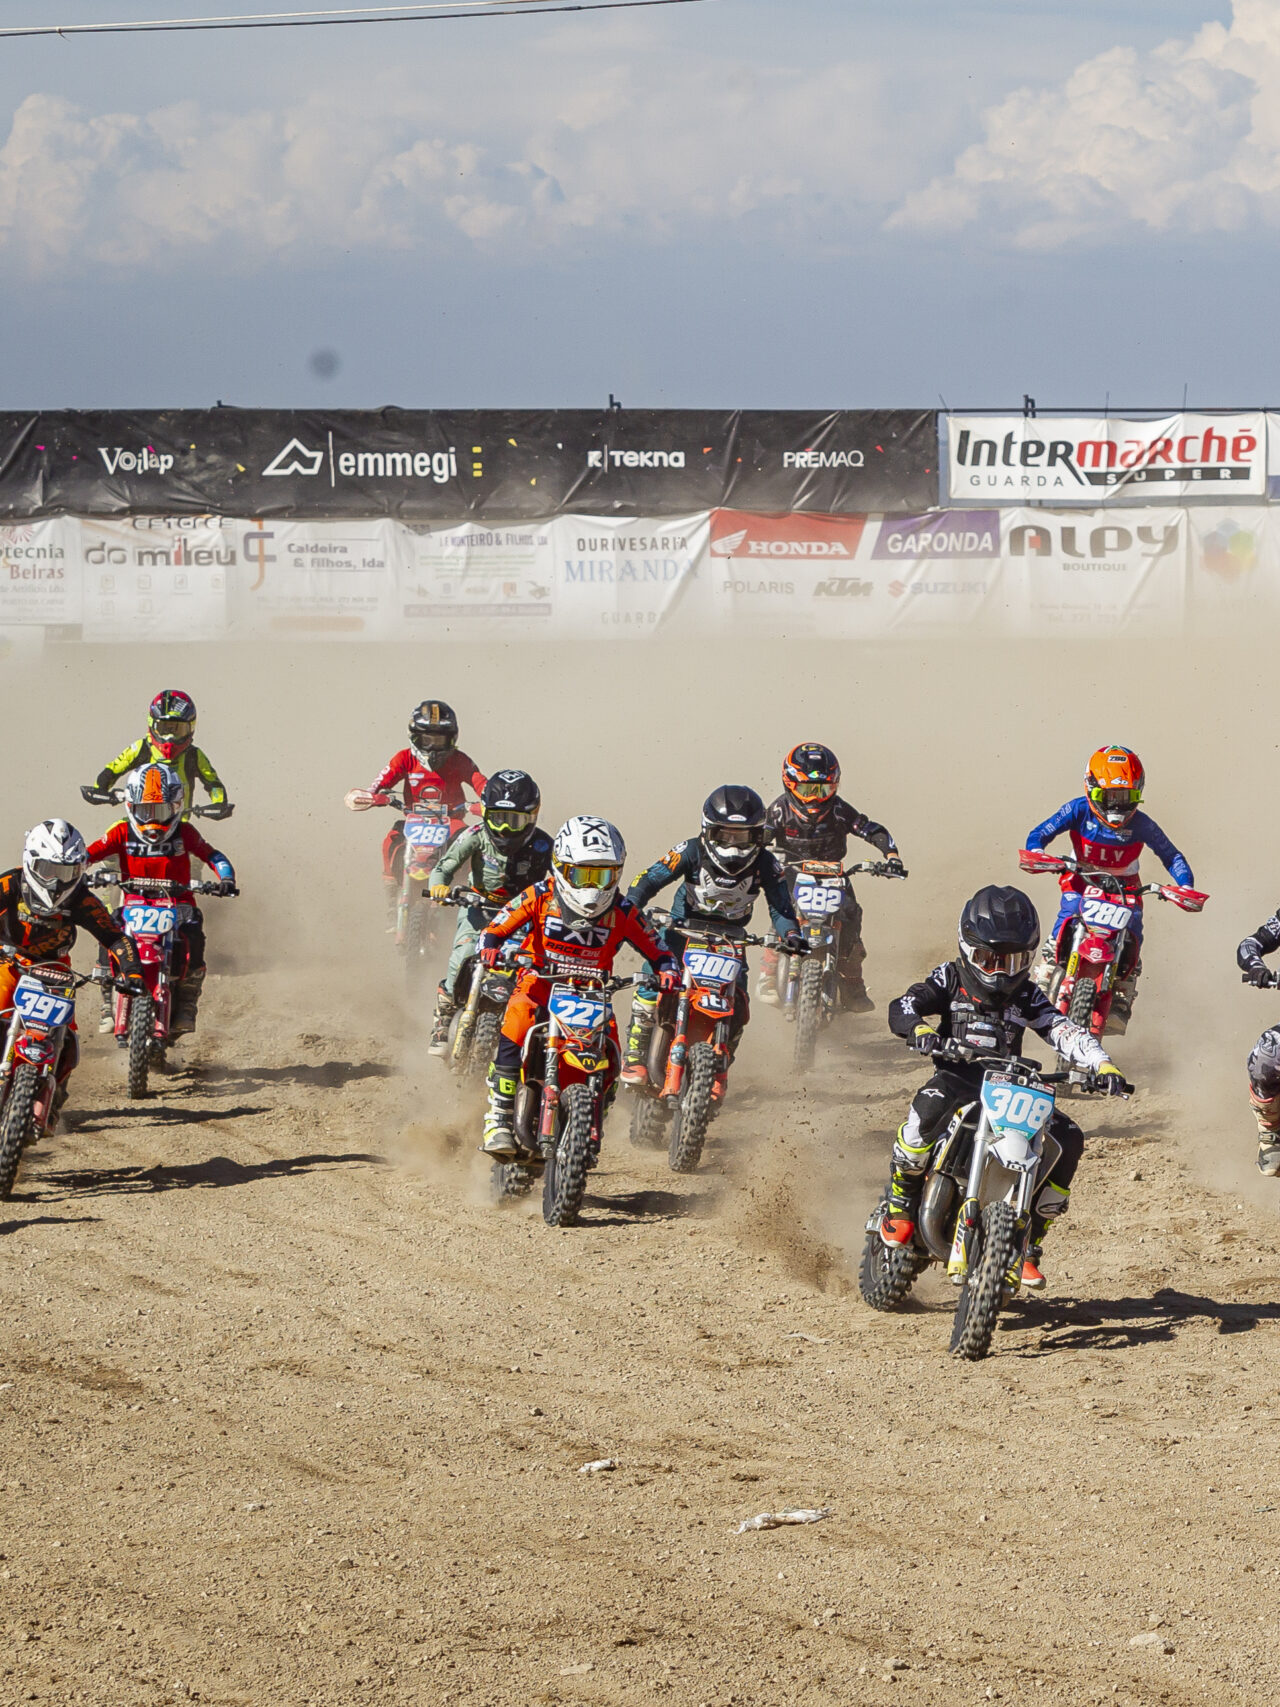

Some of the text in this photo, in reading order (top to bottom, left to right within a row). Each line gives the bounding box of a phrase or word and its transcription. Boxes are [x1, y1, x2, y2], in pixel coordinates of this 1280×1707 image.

[338, 446, 458, 483] emmegi
[783, 450, 864, 468] PREMAQ
[970, 474, 1063, 487] GUARDA
[1106, 467, 1232, 485] SUPER
[287, 542, 348, 554] Caldeira
[576, 536, 689, 552] OURIVESARIA
[748, 541, 850, 555] HONDA
[888, 531, 993, 553] GARONDA
[85, 540, 128, 566] do
[9, 565, 65, 580] Beiras
[293, 558, 305, 569] &
[723, 577, 987, 597] POLARIS KTM SUZUKI
[408, 825, 449, 845] 288
[1084, 843, 1124, 862] FLY
[797, 886, 842, 913] 282
[128, 907, 175, 933] 326
[1082, 900, 1133, 930] 280
[689, 953, 741, 982] 300
[17, 991, 72, 1025] 397
[556, 999, 611, 1028] 227
[985, 1087, 1053, 1130] 308
